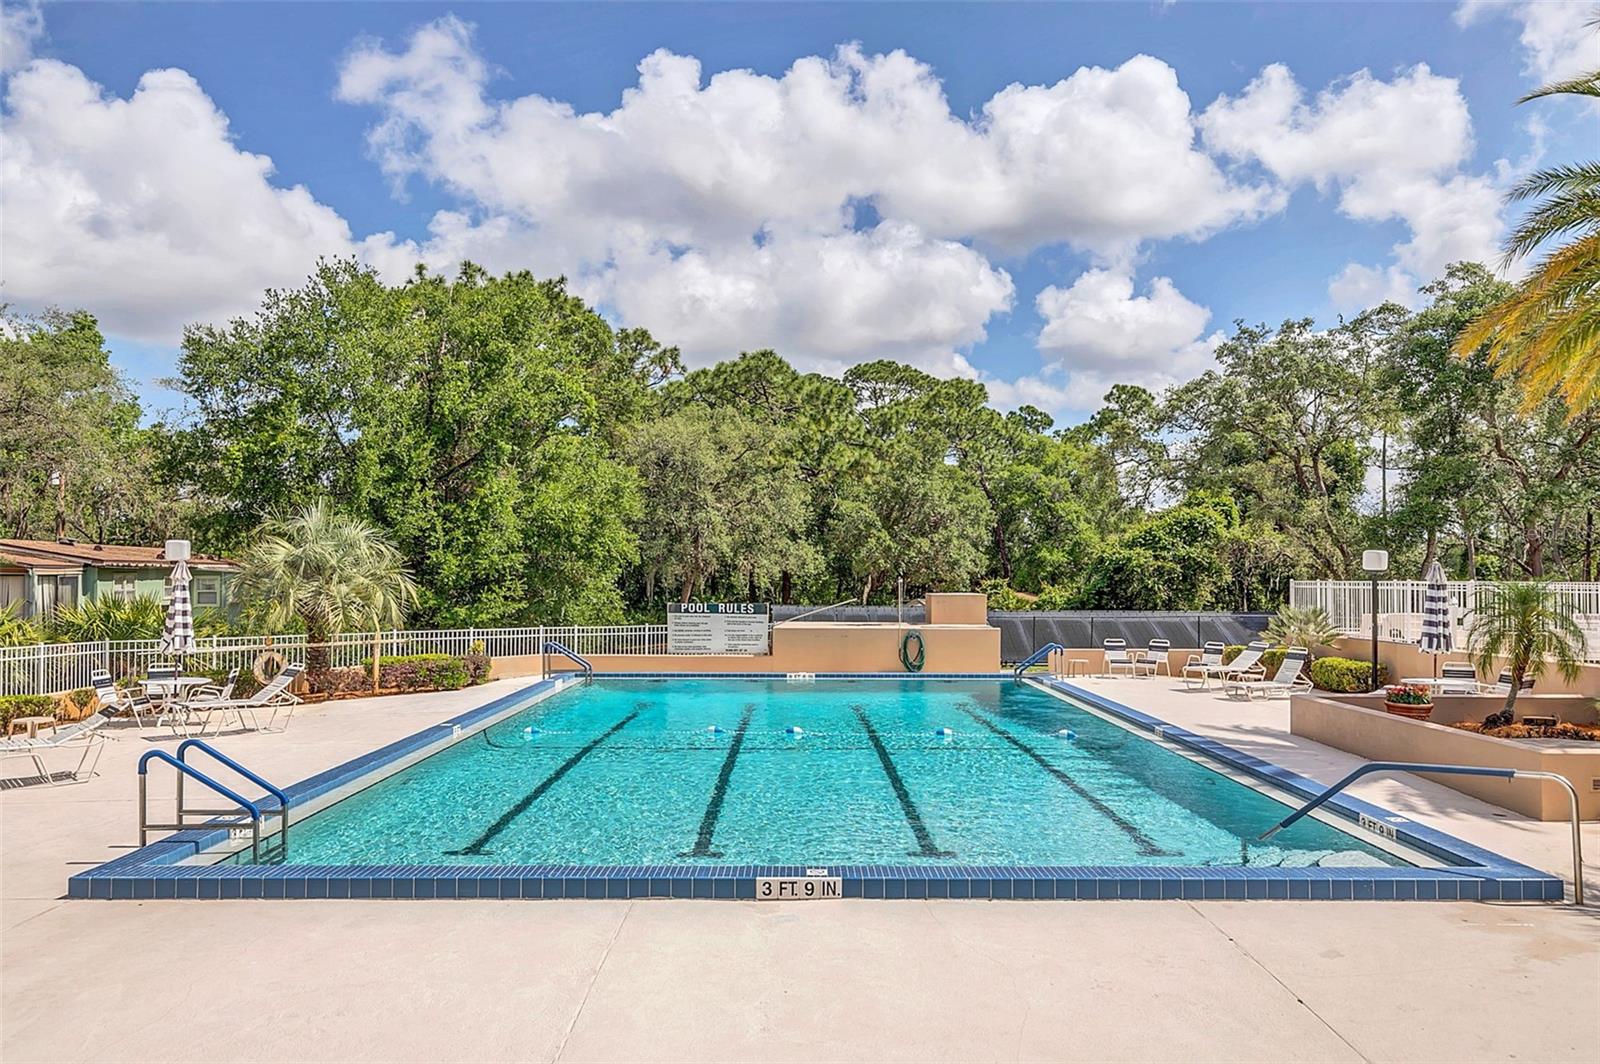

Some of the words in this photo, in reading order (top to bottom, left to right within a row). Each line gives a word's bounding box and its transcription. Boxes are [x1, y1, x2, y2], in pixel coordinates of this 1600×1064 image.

[681, 602, 710, 613] POOL
[718, 603, 754, 614] RULES
[762, 881, 772, 896] 3
[779, 881, 798, 896] FT.
[804, 881, 815, 896] 9
[822, 881, 840, 896] IN.
